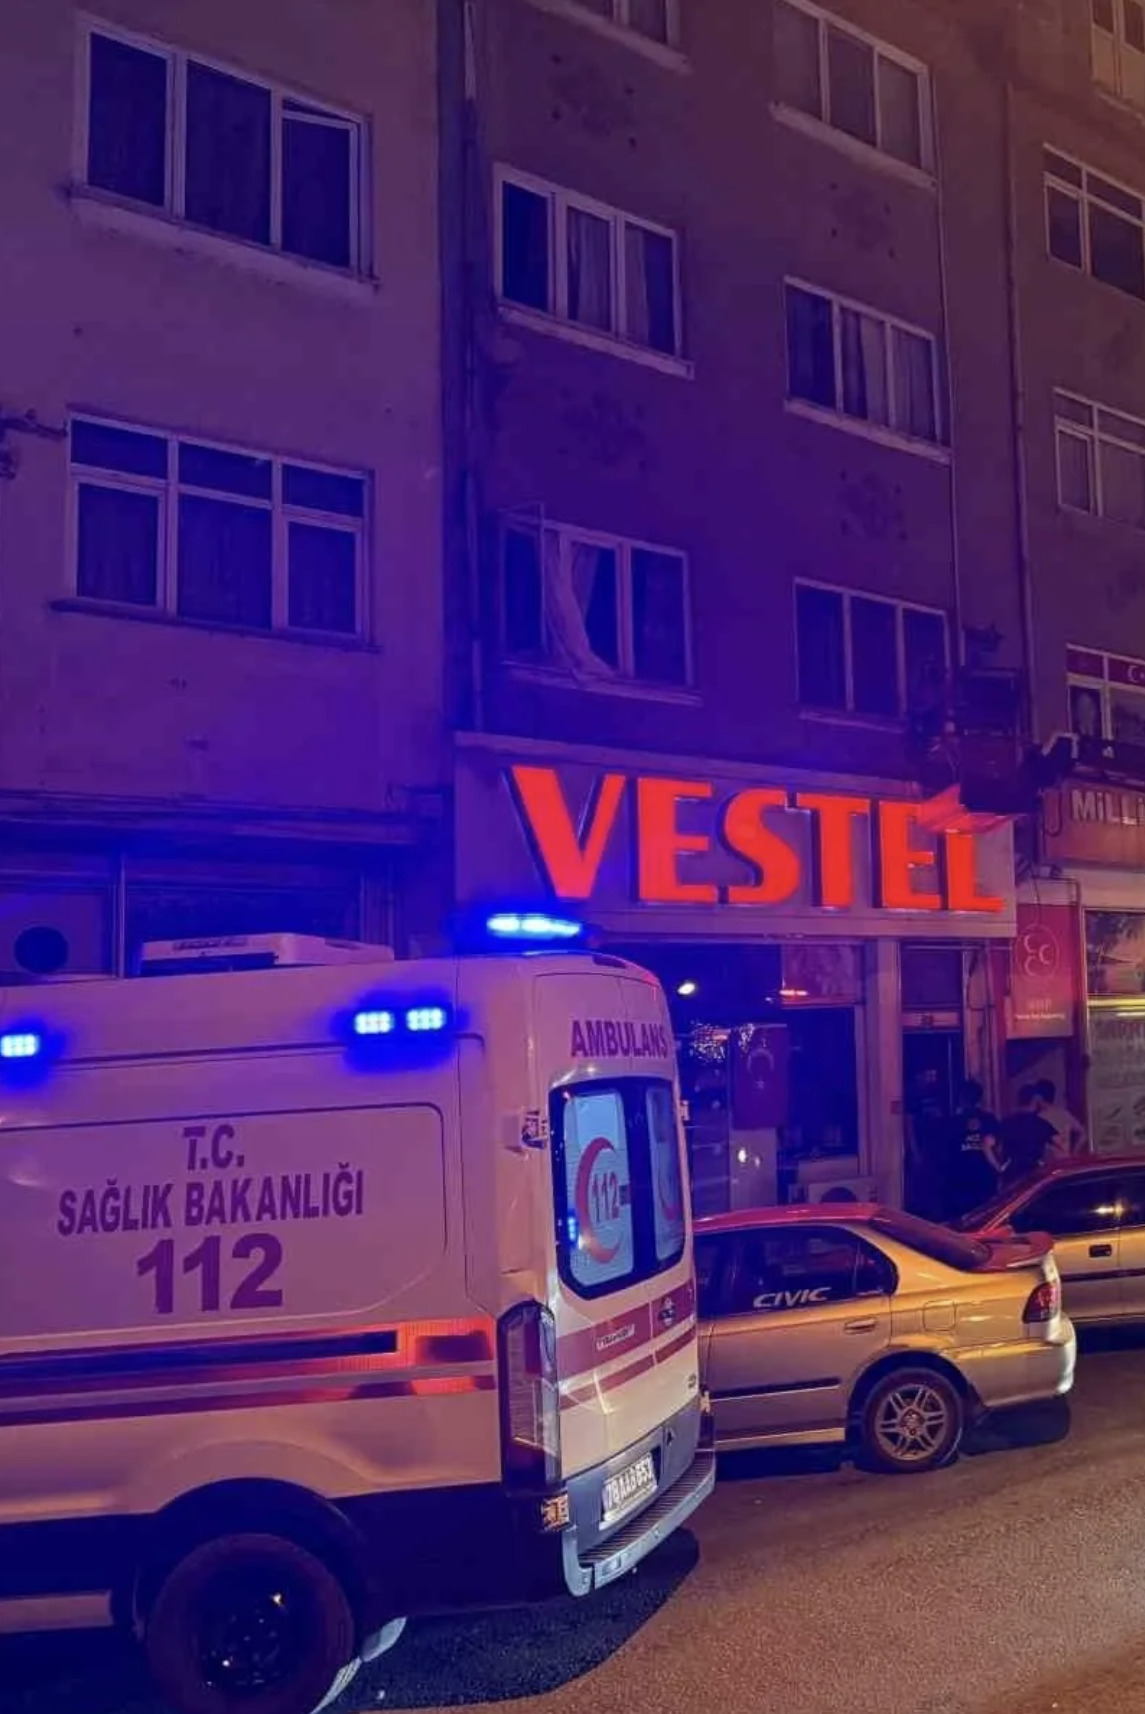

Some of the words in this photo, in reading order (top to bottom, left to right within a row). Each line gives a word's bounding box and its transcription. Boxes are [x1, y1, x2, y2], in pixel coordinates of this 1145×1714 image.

[508, 765, 1006, 912] VESTEL
[570, 1019, 669, 1059] AMBULANS
[183, 1124, 245, 1170] T.C.
[57, 1178, 173, 1235] SAĞLIK
[184, 1162, 364, 1226] BAKANLIĞI
[592, 1172, 620, 1222] 112
[137, 1233, 283, 1314] 112
[753, 1287, 832, 1308] CIVIC
